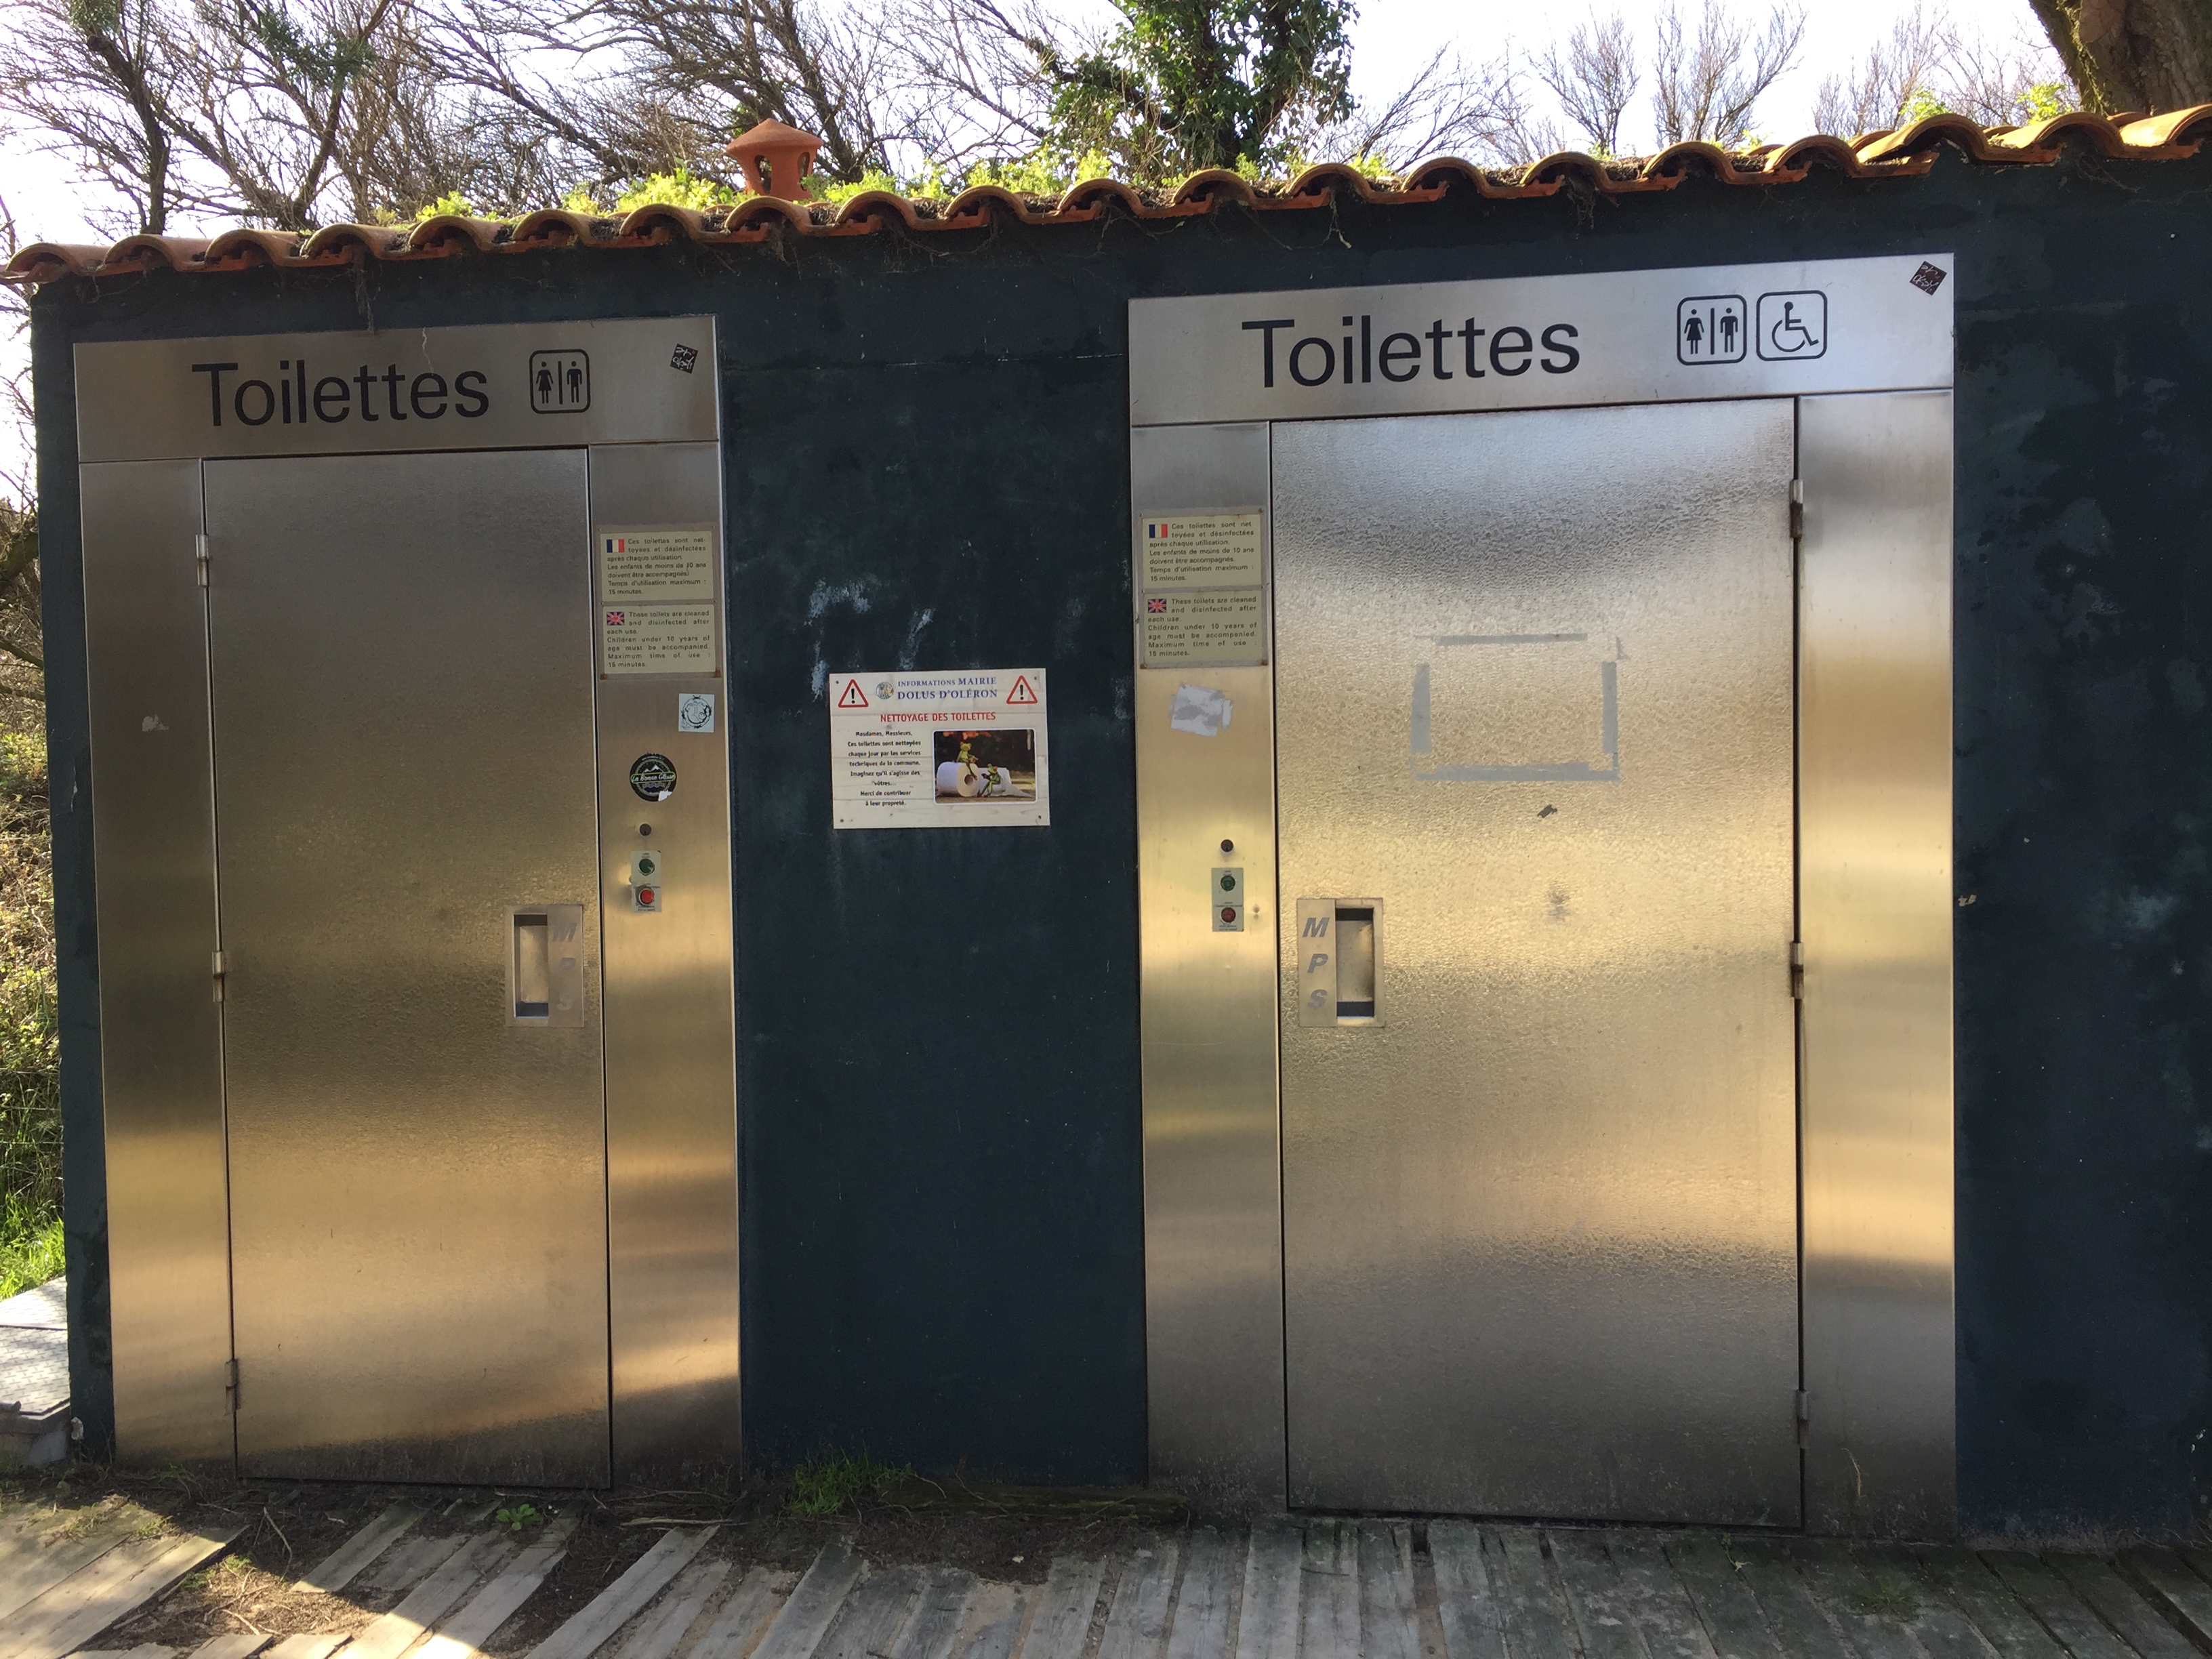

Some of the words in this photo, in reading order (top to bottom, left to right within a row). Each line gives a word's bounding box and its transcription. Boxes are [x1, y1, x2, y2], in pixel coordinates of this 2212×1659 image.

[1242, 315, 1580, 388] Toilettes
[192, 359, 489, 427] Toilettes
[958, 677, 996, 685] MAIRIE
[897, 691, 935, 699] DOLUS
[939, 689, 998, 699] D'OLÉRON
[880, 714, 928, 722] NETTOYAGE
[933, 713, 947, 721] DES
[951, 712, 996, 720] TOILETTES
